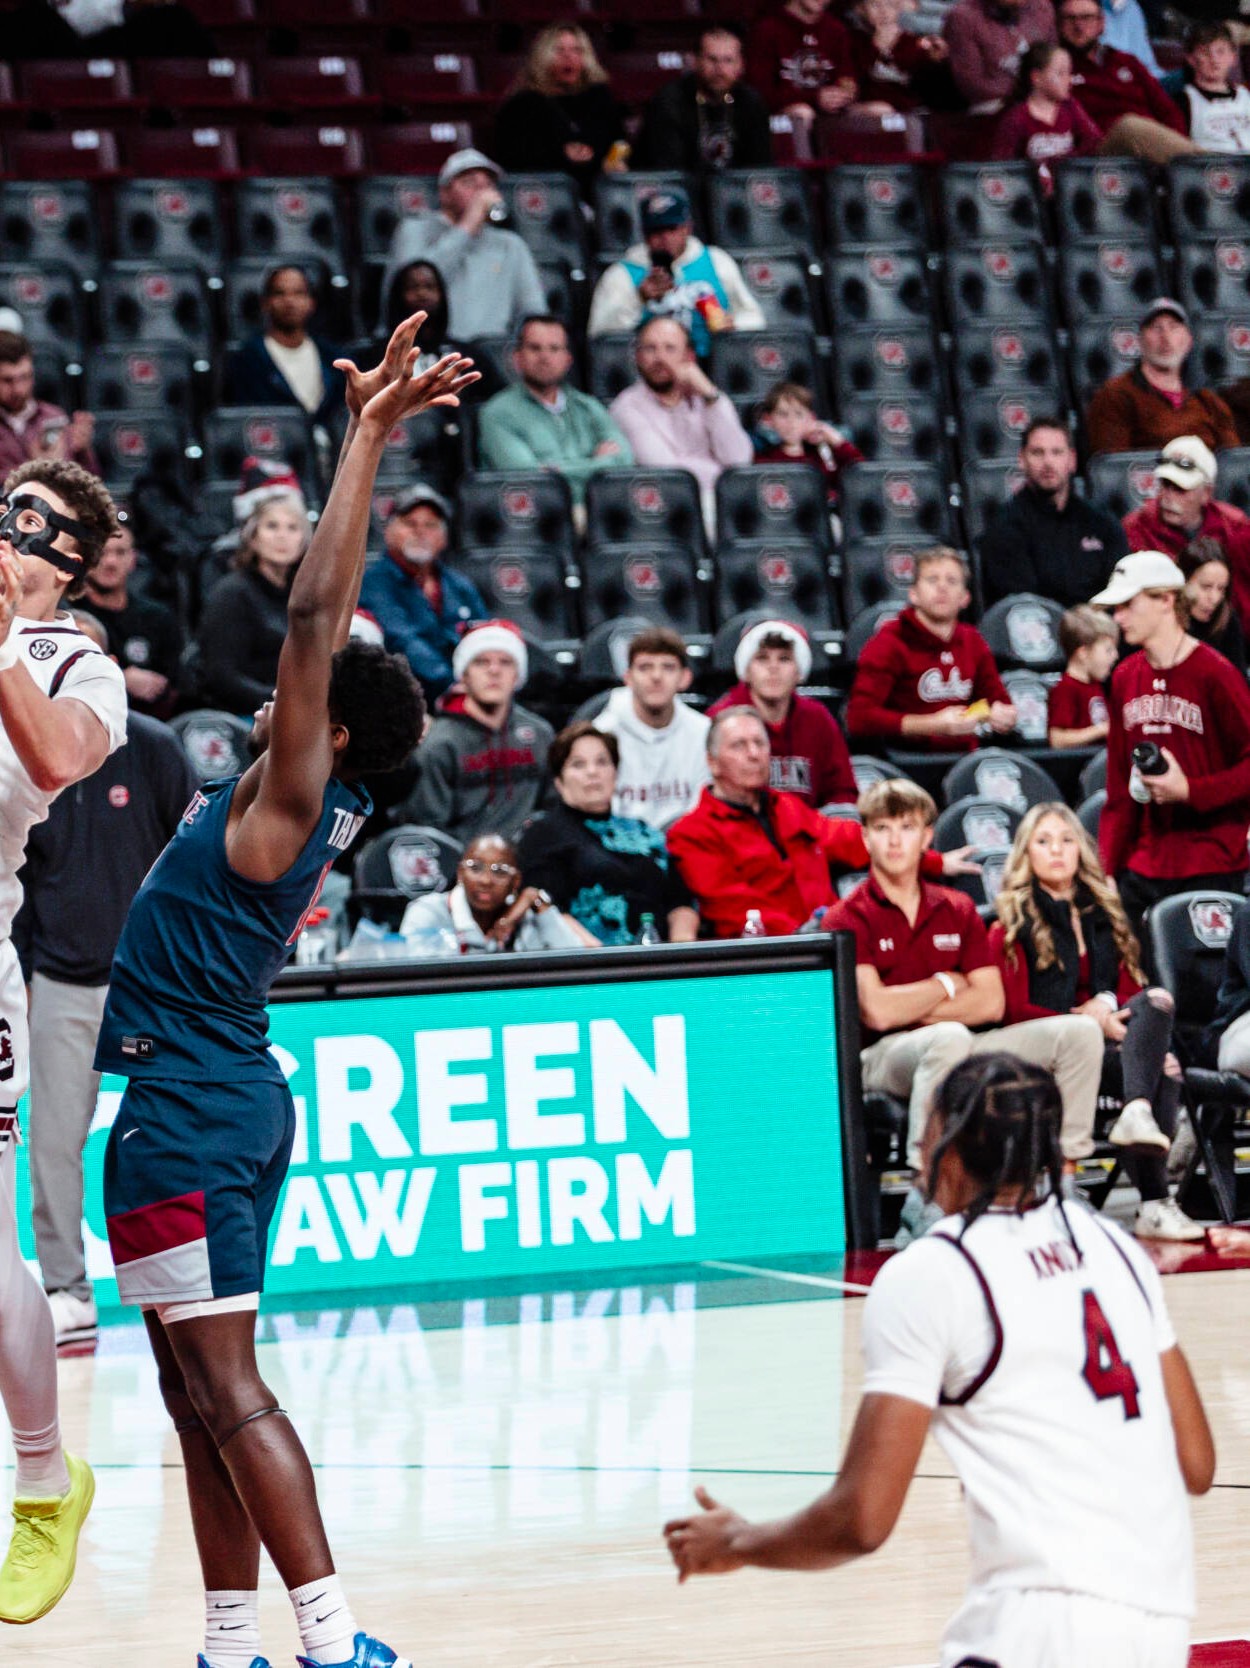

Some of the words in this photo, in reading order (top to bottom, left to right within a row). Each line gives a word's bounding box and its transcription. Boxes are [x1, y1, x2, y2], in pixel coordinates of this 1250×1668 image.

[270, 1166, 438, 1267] AW
[458, 1149, 696, 1252] FIRM
[1080, 1286, 1142, 1421] 4
